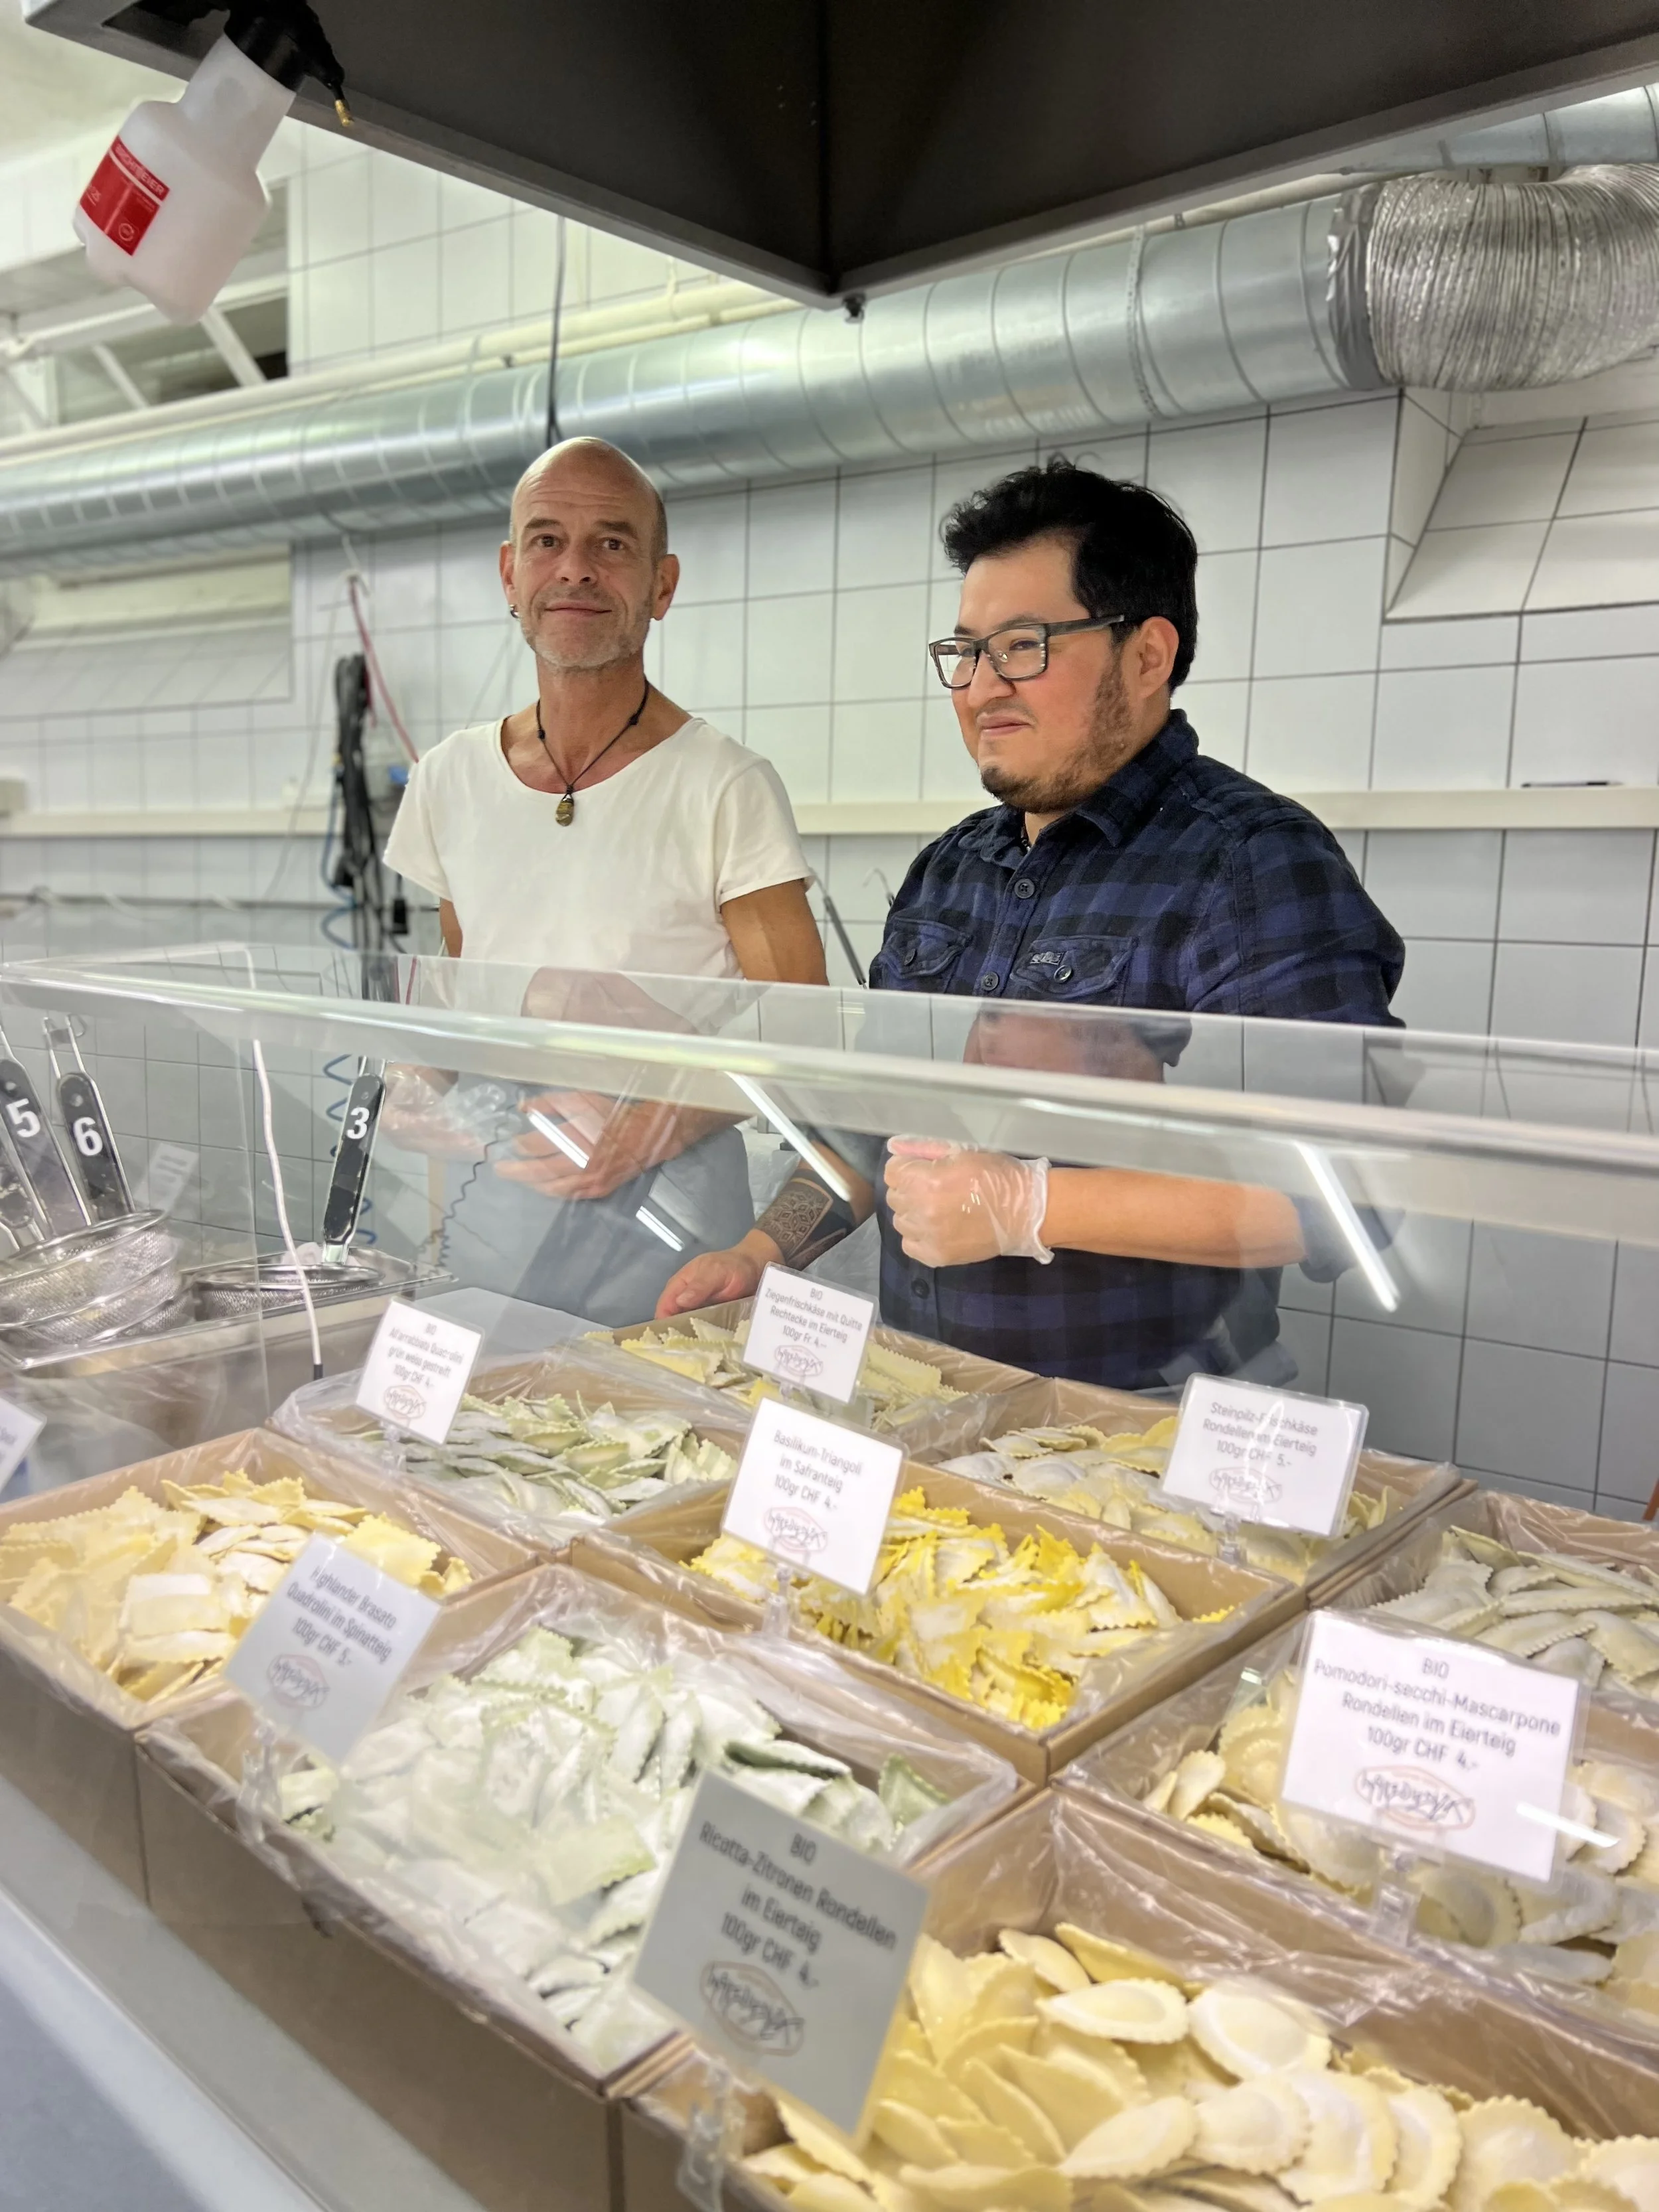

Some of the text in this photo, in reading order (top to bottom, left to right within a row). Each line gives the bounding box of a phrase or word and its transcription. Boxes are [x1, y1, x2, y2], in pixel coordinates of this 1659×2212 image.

[6, 1098, 40, 1138] 5
[73, 1117, 103, 1156] 6
[346, 1106, 370, 1140] 3
[765, 1288, 862, 1331] Ziegenfrischkäse mit Quitte
[810, 1288, 822, 1300] BIO
[770, 1305, 847, 1343] Rechtecke im Eierteig
[782, 1325, 802, 1341] 100gr
[1202, 1418, 1316, 1457] Rondellen im Eierteig
[1210, 1402, 1317, 1435] Steinpilz-Fischkäse
[774, 1430, 861, 1474] Basilikum-Triangoli
[1217, 1439, 1246, 1459] 100gr
[774, 1474, 799, 1497] 100gr
[800, 1485, 820, 1503] CHF
[779, 1456, 842, 1493] im Safranteig
[287, 1582, 392, 1663] Quadrolini im Spinatteig
[357, 1595, 396, 1629] Brasato
[292, 1617, 321, 1646] 100gr
[317, 1634, 341, 1655] CHF
[1421, 1657, 1449, 1678] BIO
[1315, 1659, 1559, 1735] Pomodori-secchi-Mascarpone
[1342, 1692, 1515, 1757] Rondellen im Eierteig
[1368, 1726, 1409, 1755] 100gr
[1413, 1738, 1446, 1761] CHF
[790, 1833, 816, 1864] BIO
[699, 1822, 895, 1948] Ricotta-Zitronen Rondellen
[741, 1889, 820, 1954] im Eierteig
[721, 1913, 760, 1954] 100gr
[762, 1938, 793, 1970] CHF
